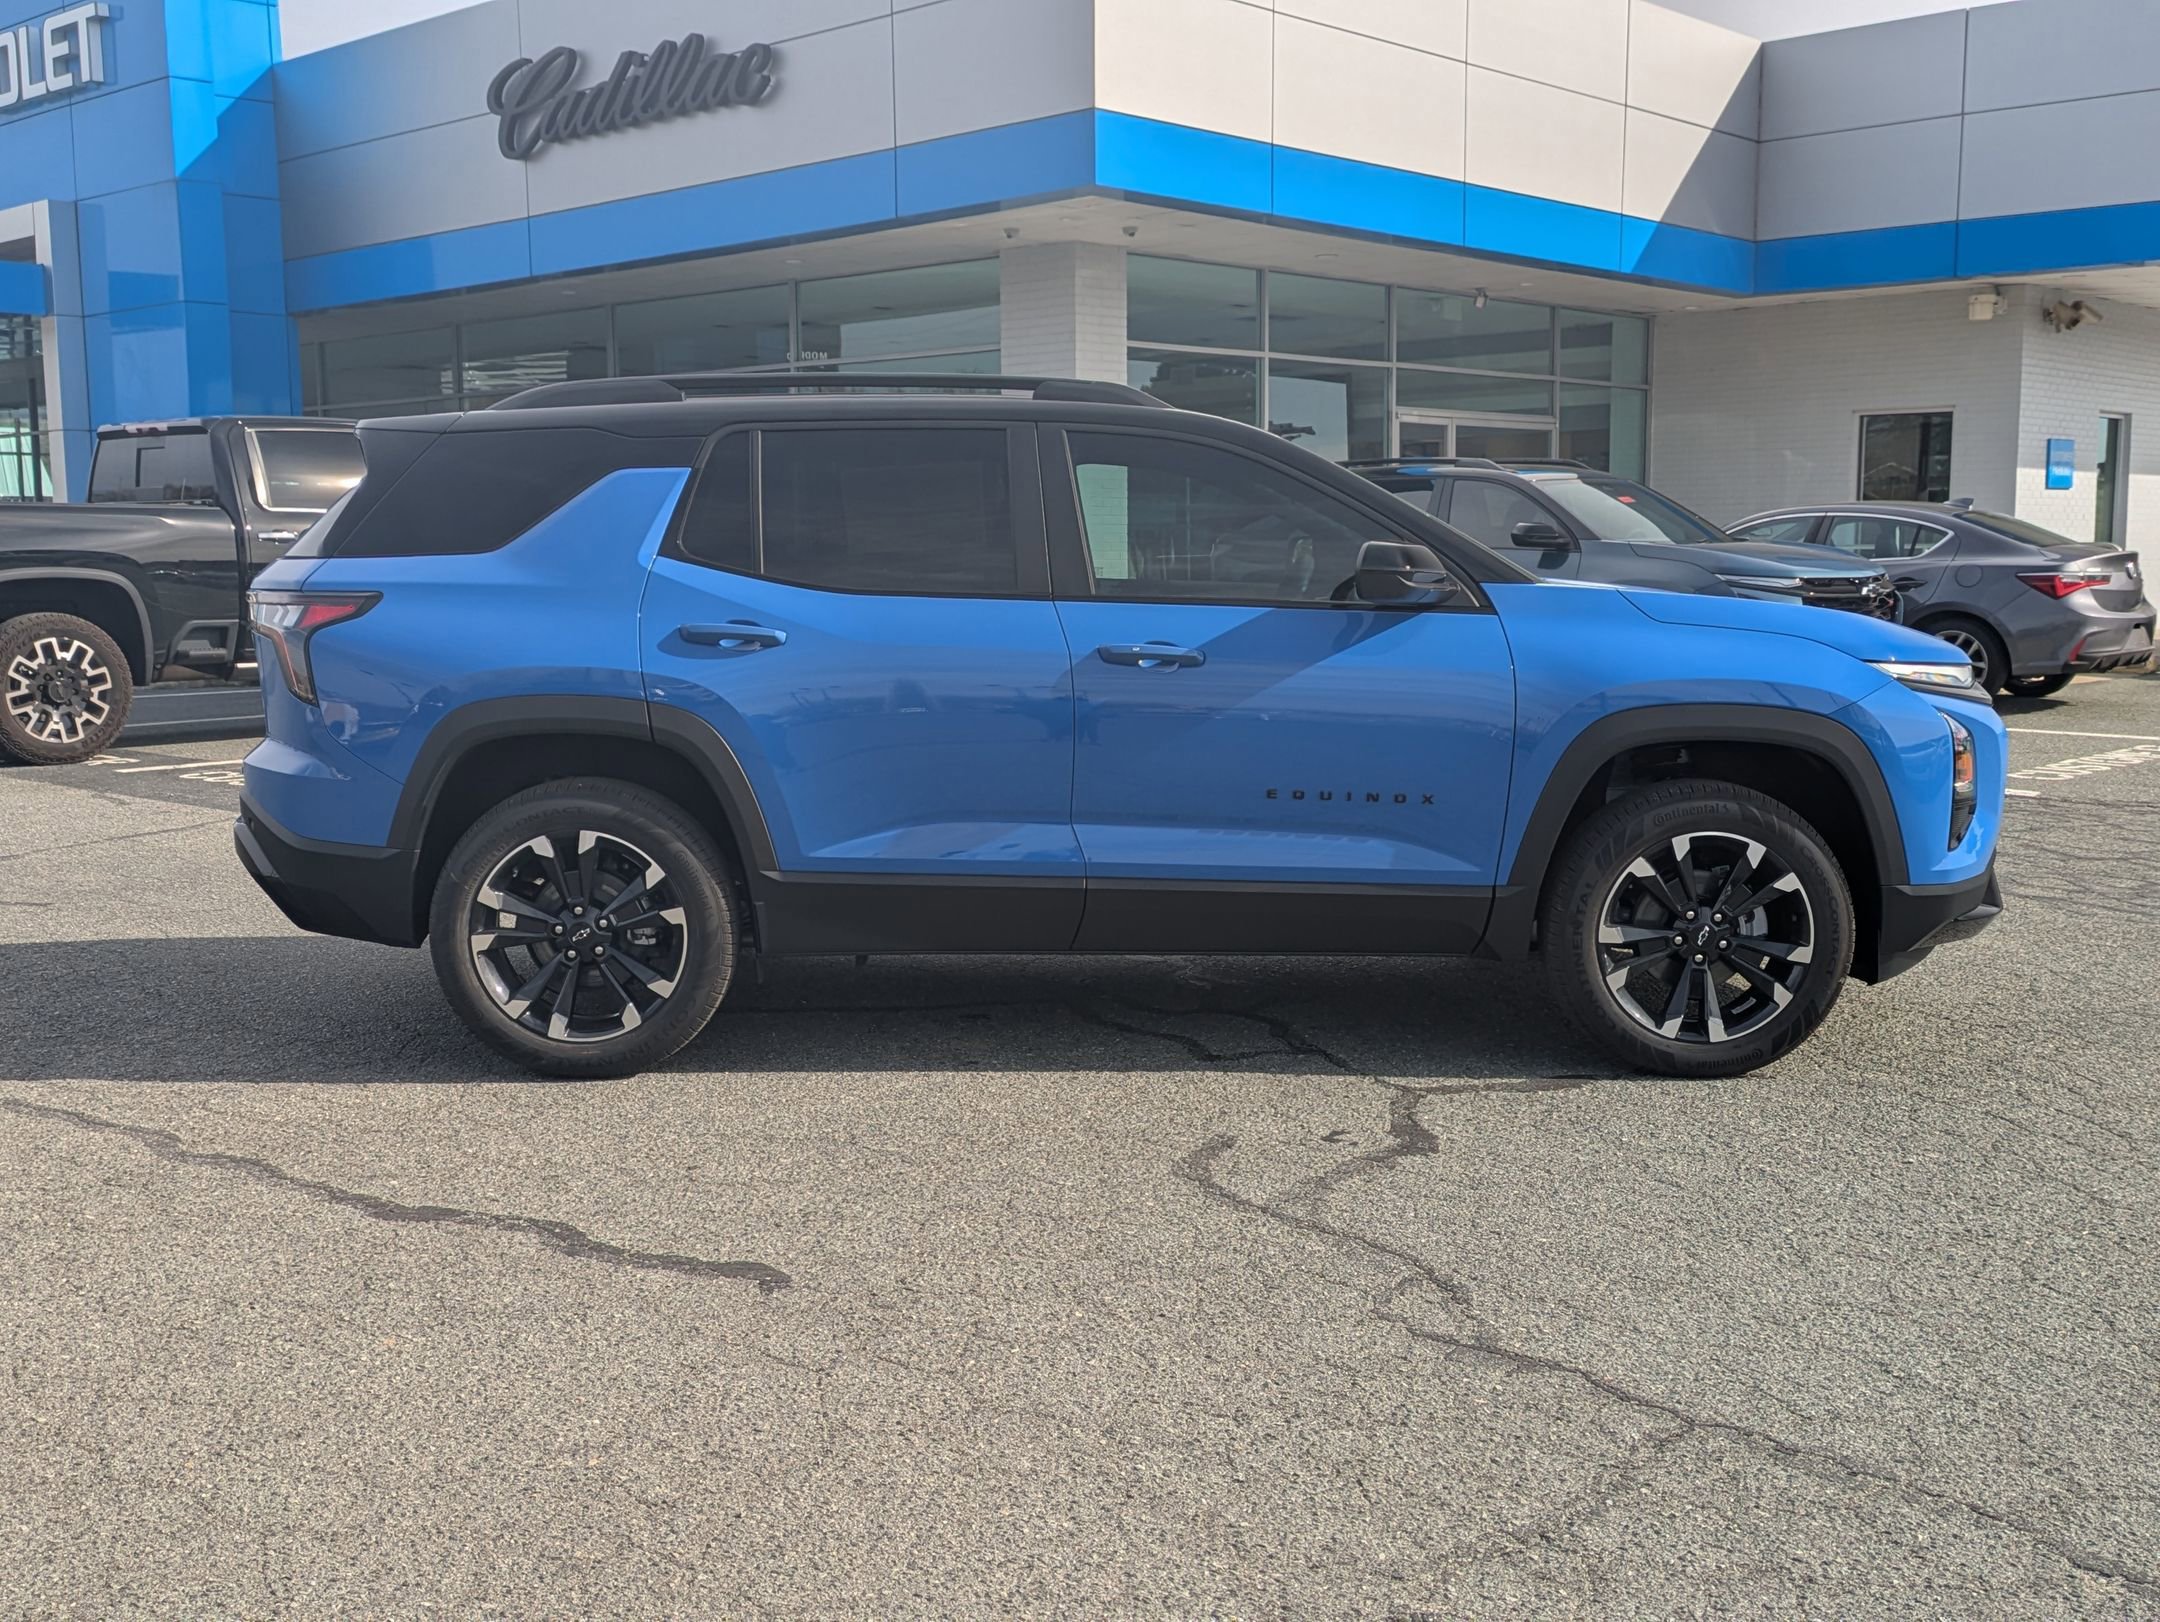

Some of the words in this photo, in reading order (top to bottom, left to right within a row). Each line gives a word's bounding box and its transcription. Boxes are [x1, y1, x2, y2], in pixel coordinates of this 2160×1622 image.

[487, 33, 771, 160] Cadillac
[1266, 787, 1434, 805] EQUINOX
[1653, 802, 1720, 827] Continental
